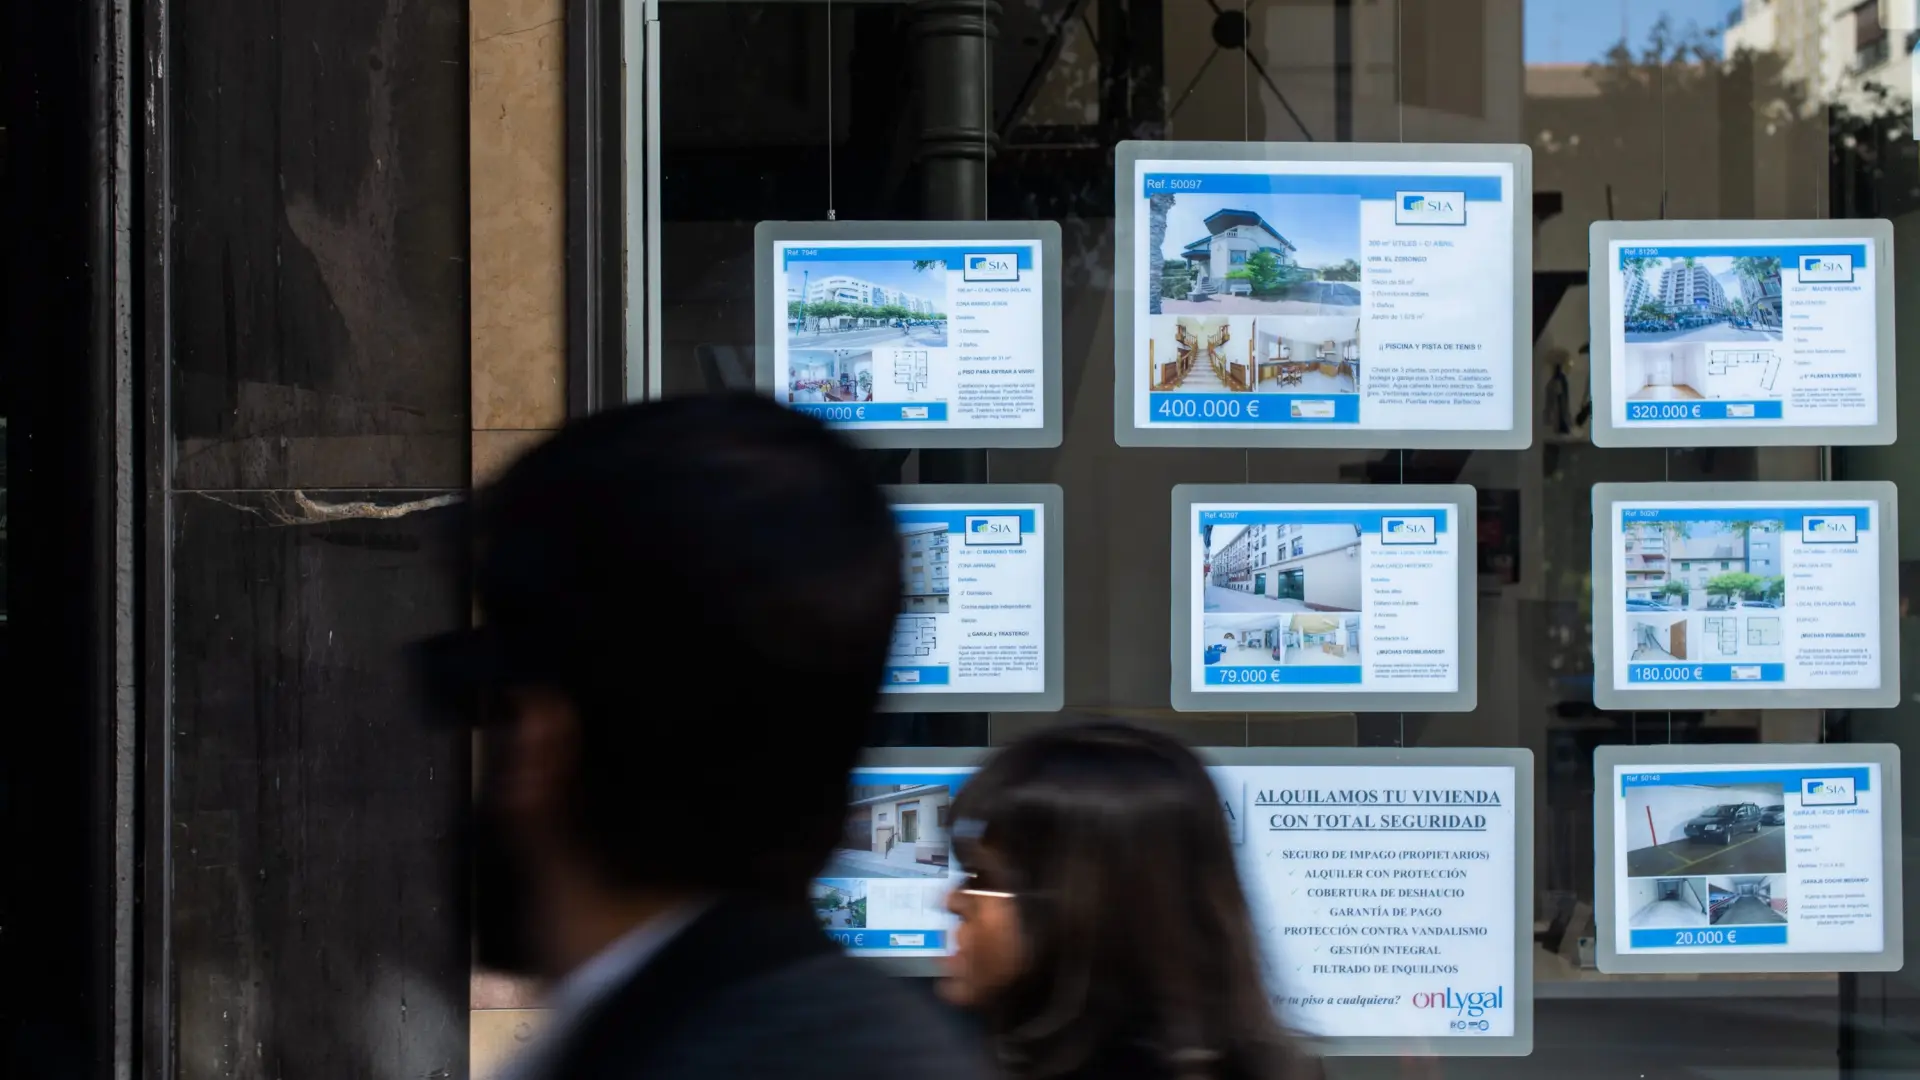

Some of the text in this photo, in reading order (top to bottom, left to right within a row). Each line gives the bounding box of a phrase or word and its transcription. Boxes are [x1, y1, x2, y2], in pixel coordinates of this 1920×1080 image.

[1147, 179, 1202, 189] Ref. 50097
[1428, 201, 1454, 212] SIA
[988, 261, 1009, 270] SIA
[1823, 262, 1843, 271] SIA
[856, 407, 866, 419] €
[1158, 399, 1260, 418] 400.000 €
[1632, 404, 1700, 418] 320.000 €
[990, 524, 1011, 533] SIA
[1406, 525, 1426, 533] SIA
[1827, 524, 1847, 532] SIA
[1220, 670, 1280, 682] 79.000 €
[1635, 668, 1702, 680] 180.000 €
[1826, 785, 1846, 794] SIA
[1256, 789, 1501, 804] ALQUILAMOS TU VIVIENDA
[1270, 814, 1486, 829] CON TOTAL SEGURIDAD
[1282, 850, 1490, 860] SEGURO DE IMPAGO (PROPIETARIOS)
[1304, 868, 1467, 879] ALQUILER CON PROTECCIÓN
[1307, 888, 1465, 898] COBERTURA DE DESHAUCIO
[1330, 906, 1442, 917] GARANTÍA DE PAGO
[1284, 924, 1488, 936] PROTECCIÓN CONTRA VANDALISMO
[854, 934, 864, 946] €
[1676, 930, 1736, 944] 20.000 €
[1330, 944, 1441, 955] GESTIÓN INTEGRAL
[1313, 964, 1459, 975] FILTRADO DE INQUILINOS
[1288, 996, 1299, 1005] tu
[1301, 995, 1324, 1008] piso
[1336, 995, 1401, 1008] cualquiera?
